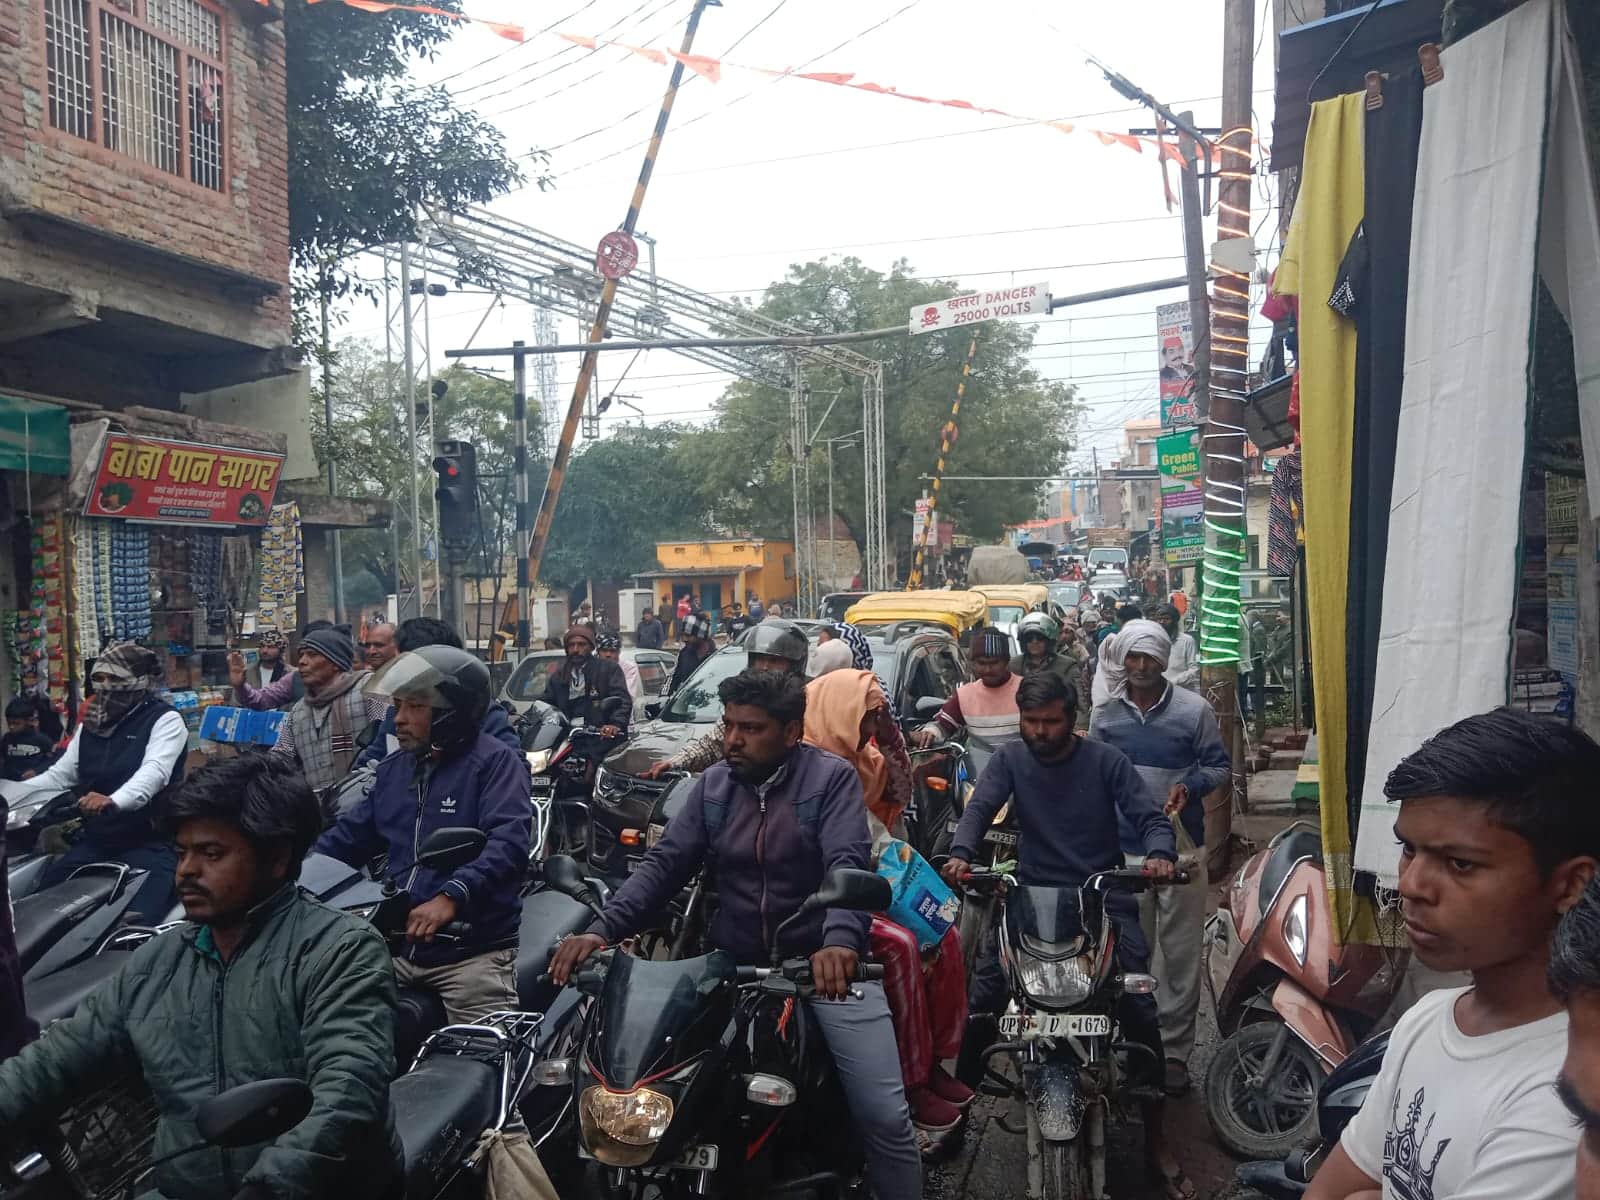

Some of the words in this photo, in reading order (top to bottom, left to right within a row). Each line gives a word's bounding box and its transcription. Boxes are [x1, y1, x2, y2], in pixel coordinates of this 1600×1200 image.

[947, 295, 980, 310] खतरा
[985, 286, 1037, 304] DANGER
[953, 307, 990, 325] 25000
[993, 301, 1031, 317] VOLTS
[107, 441, 167, 481] बाबा
[168, 449, 217, 484] पान
[216, 455, 280, 492] सागर
[1161, 451, 1195, 466] Green
[1171, 463, 1198, 475] Public
[1077, 1017, 1109, 1033] 1679
